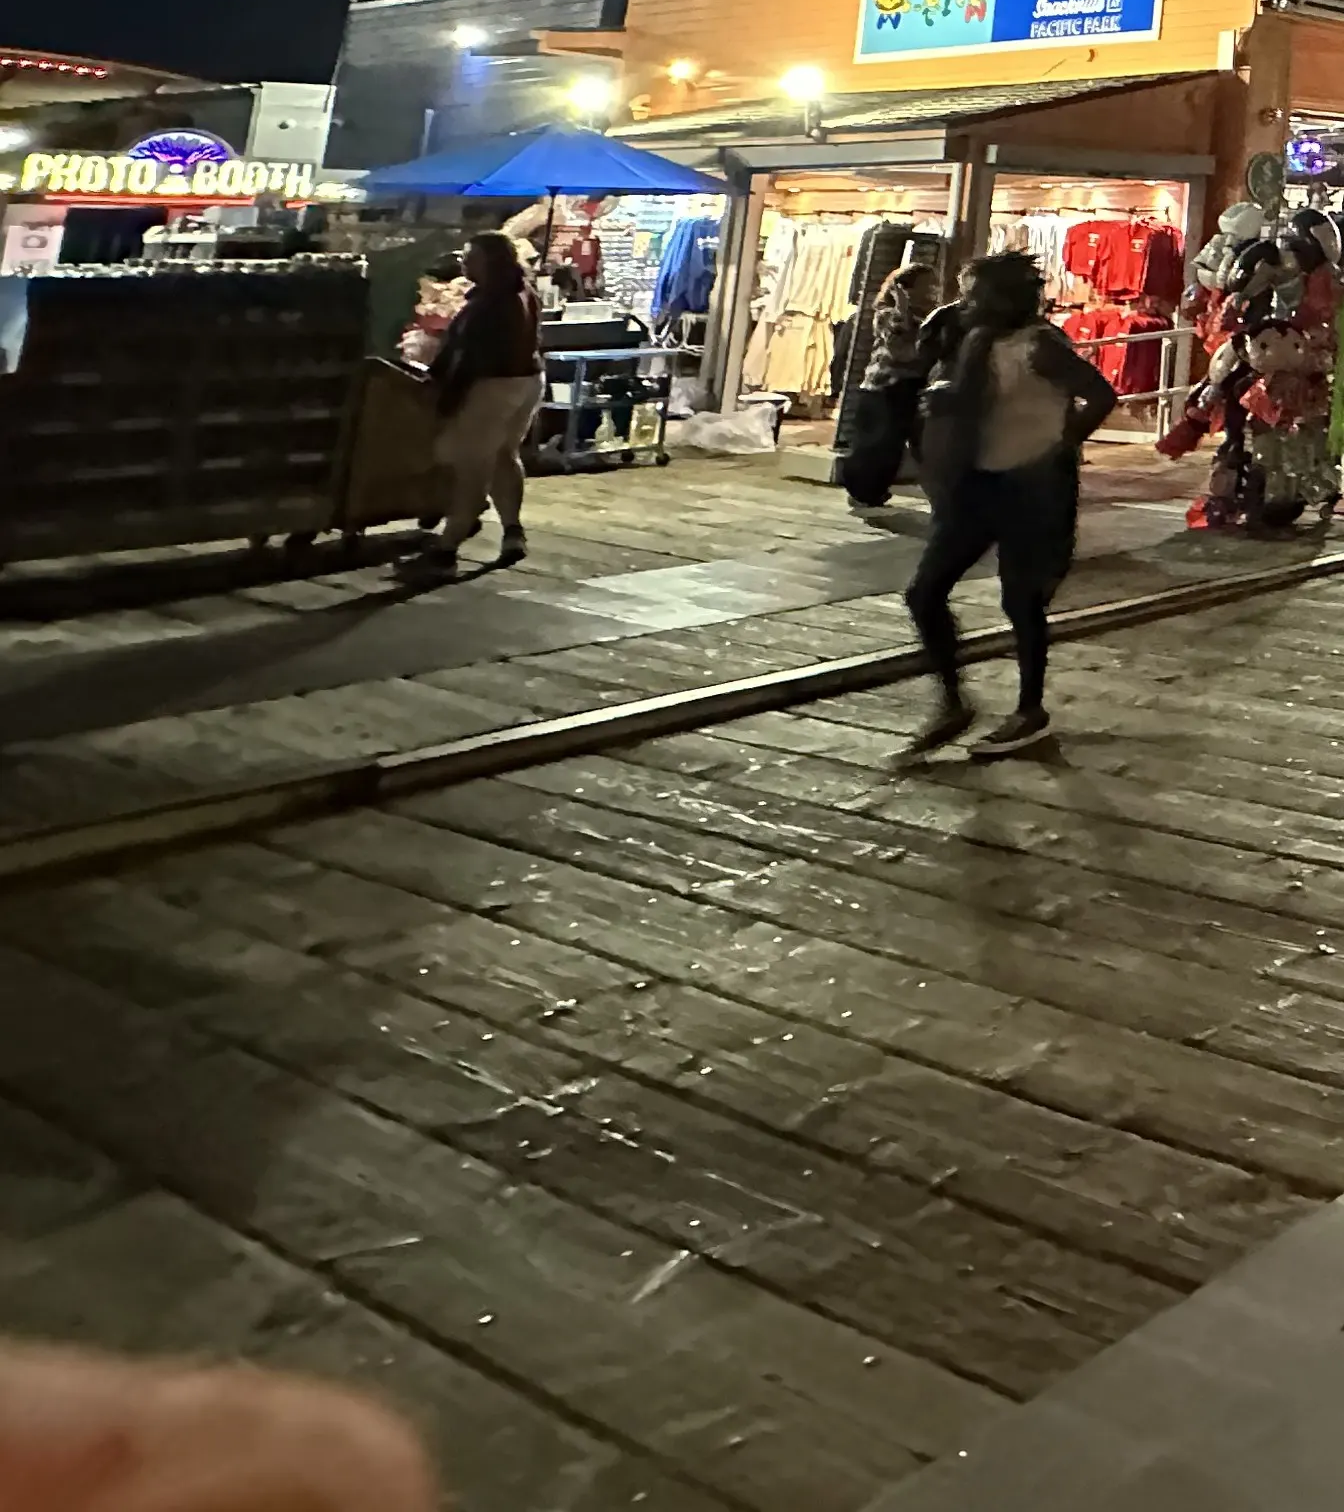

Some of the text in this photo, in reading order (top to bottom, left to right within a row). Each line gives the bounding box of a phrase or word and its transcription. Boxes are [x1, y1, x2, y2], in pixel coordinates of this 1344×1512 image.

[1030, 14, 1122, 38] PACIFIC PARK
[21, 153, 314, 198] PHOTO BOOTH
